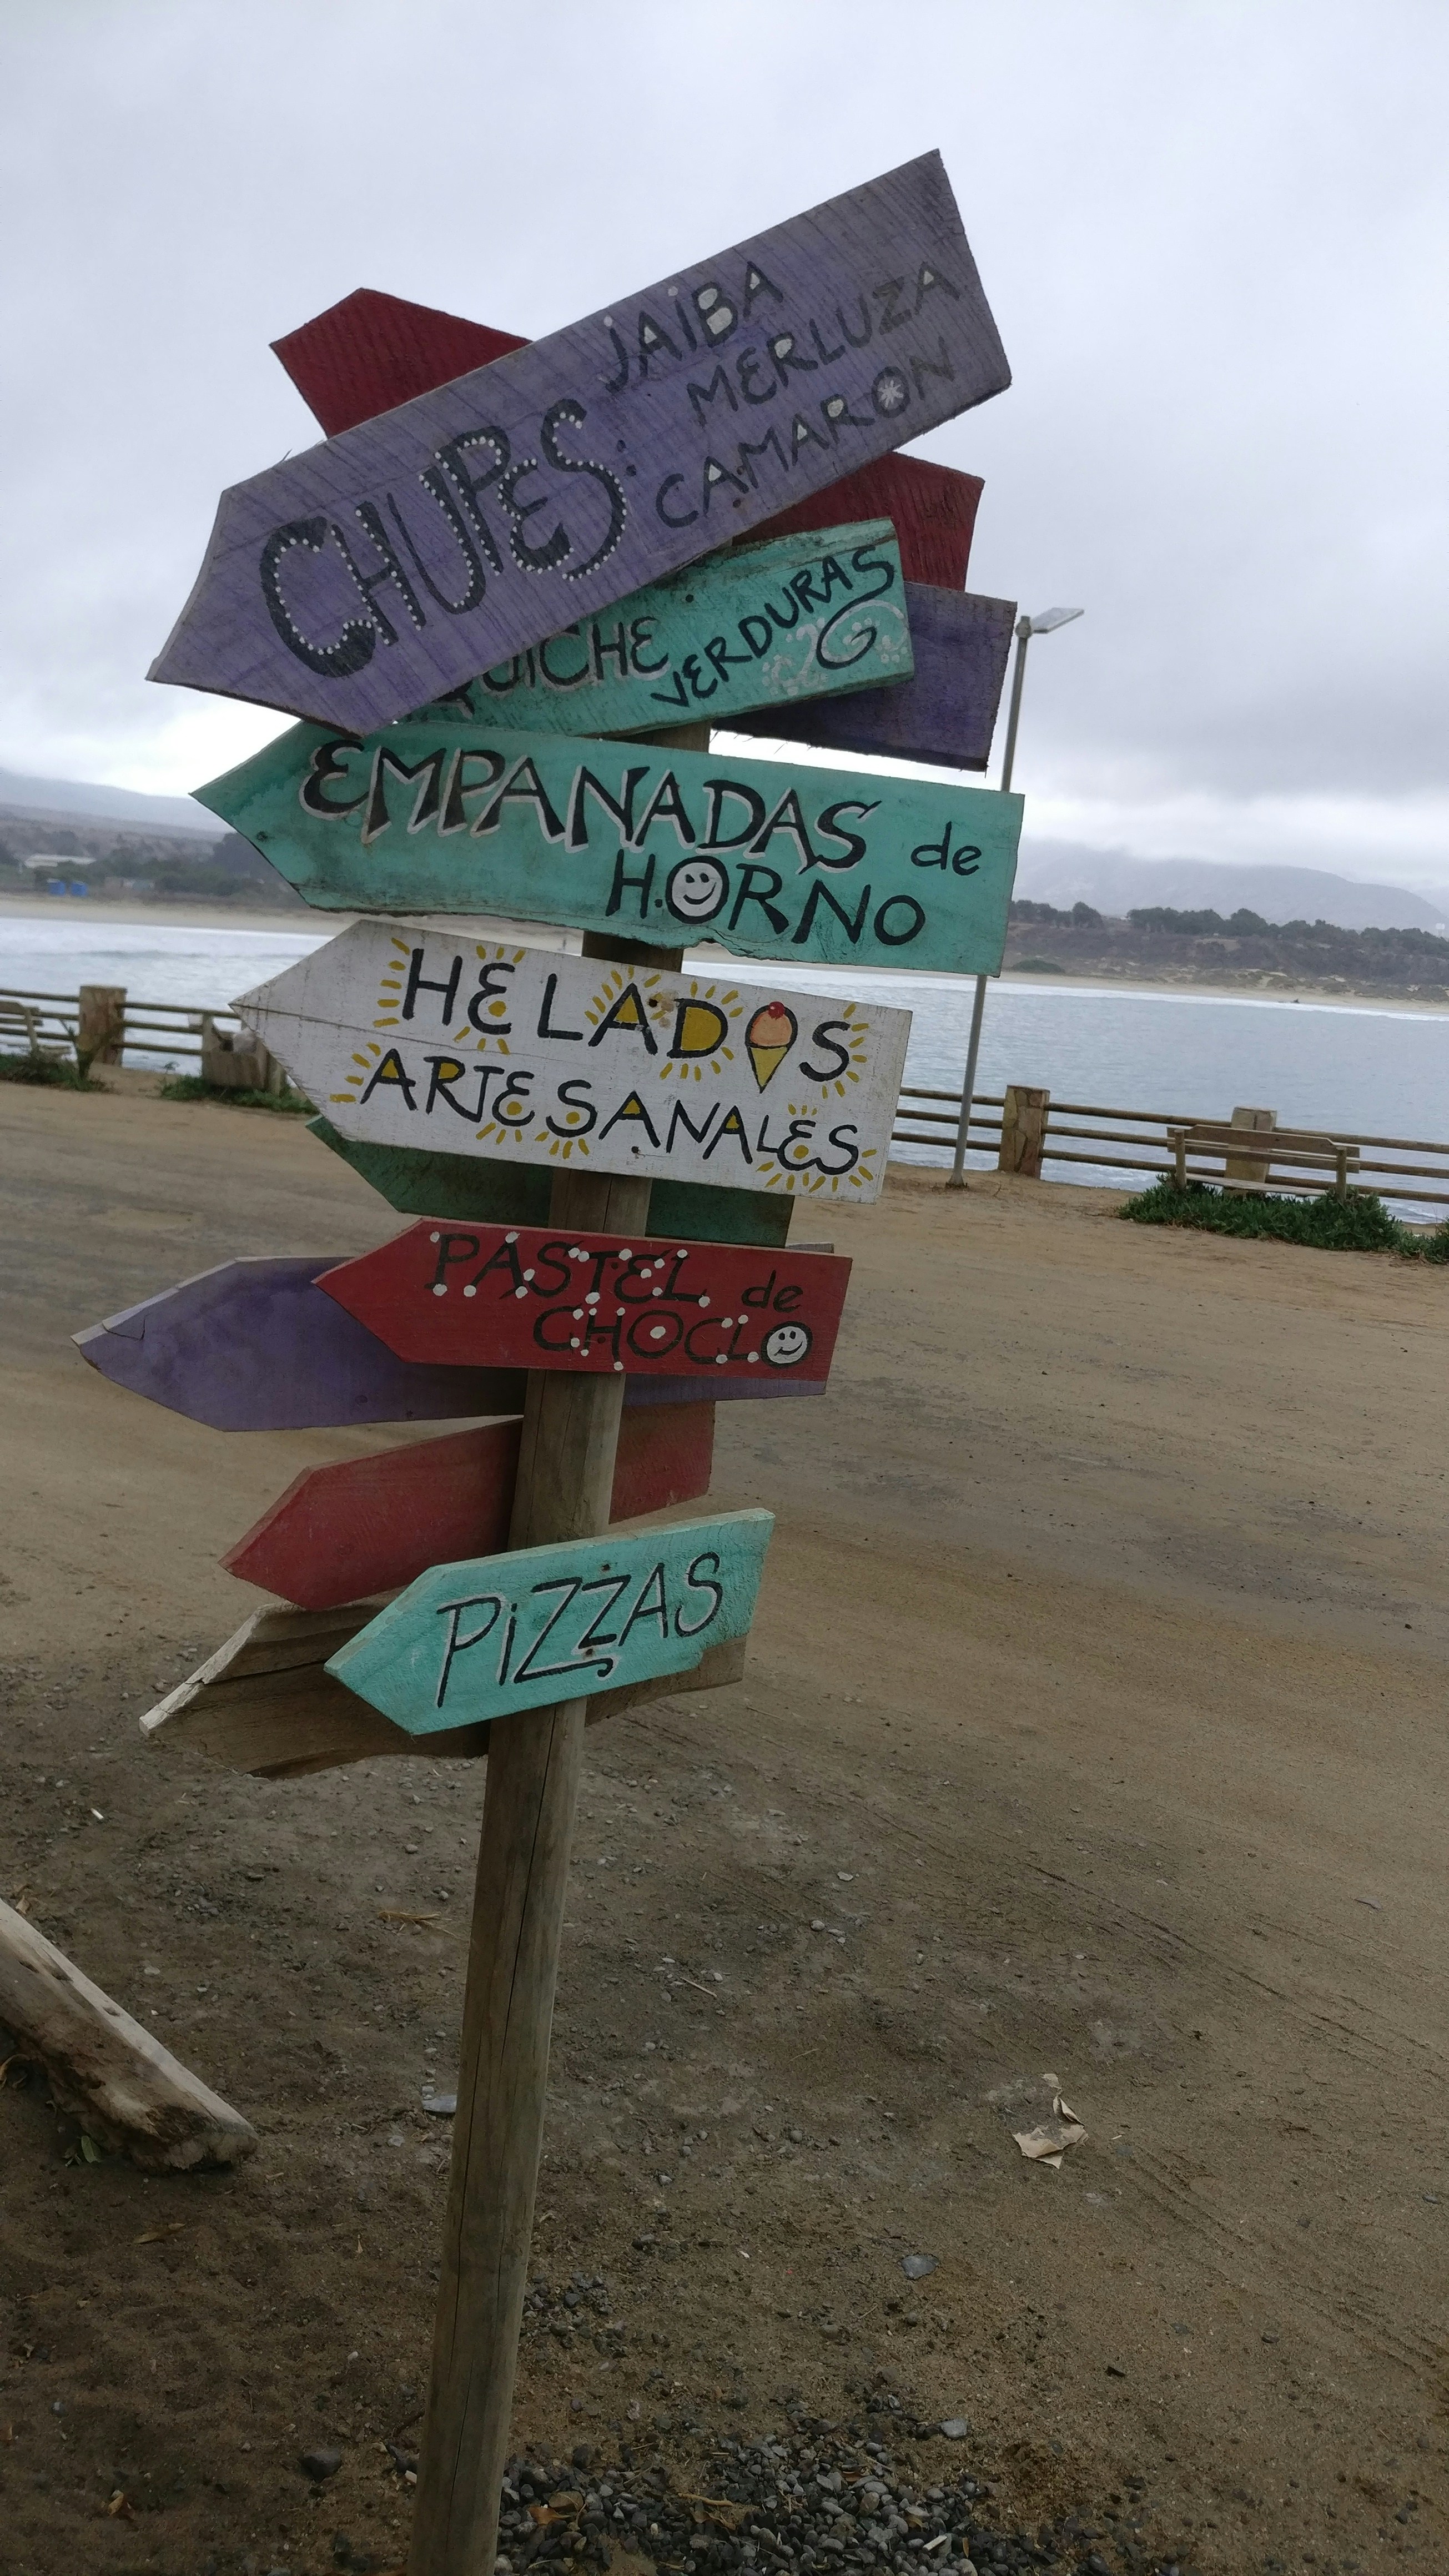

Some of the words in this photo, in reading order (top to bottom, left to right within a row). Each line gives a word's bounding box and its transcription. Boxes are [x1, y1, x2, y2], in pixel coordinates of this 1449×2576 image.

[596, 260, 783, 393] JAIBA
[686, 261, 960, 427] MERLUZA
[656, 335, 956, 528] CAMARON
[651, 546, 895, 707] VERDURAS
[299, 739, 883, 876] EMPANADAS
[910, 821, 982, 876] de
[605, 849, 926, 946] HORNO
[360, 1048, 858, 1165] ARTESANALES
[424, 1231, 711, 1306] PASTEL
[742, 1270, 803, 1313] de
[533, 1305, 813, 1371] CHOCLO
